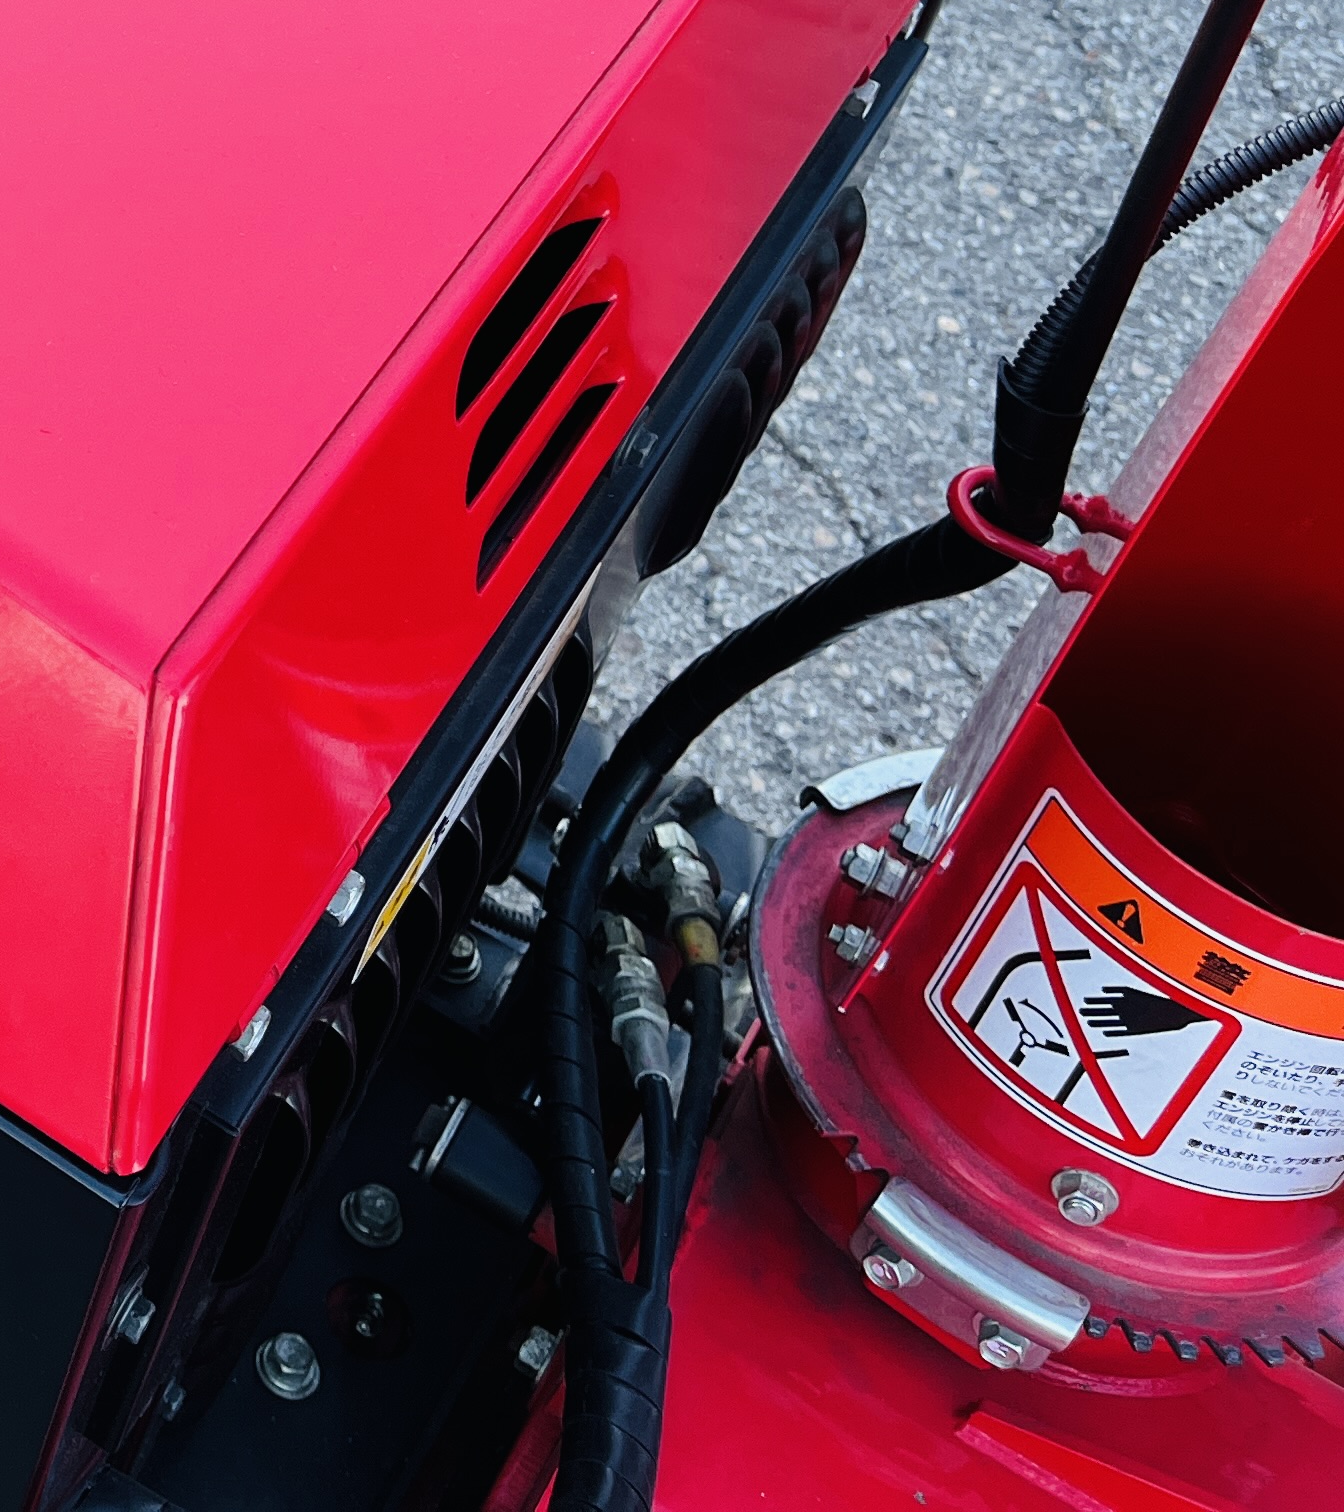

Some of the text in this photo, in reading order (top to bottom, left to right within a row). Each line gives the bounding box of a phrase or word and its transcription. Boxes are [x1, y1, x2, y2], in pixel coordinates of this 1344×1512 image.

[1247, 1050, 1344, 1075] エンジン回転
